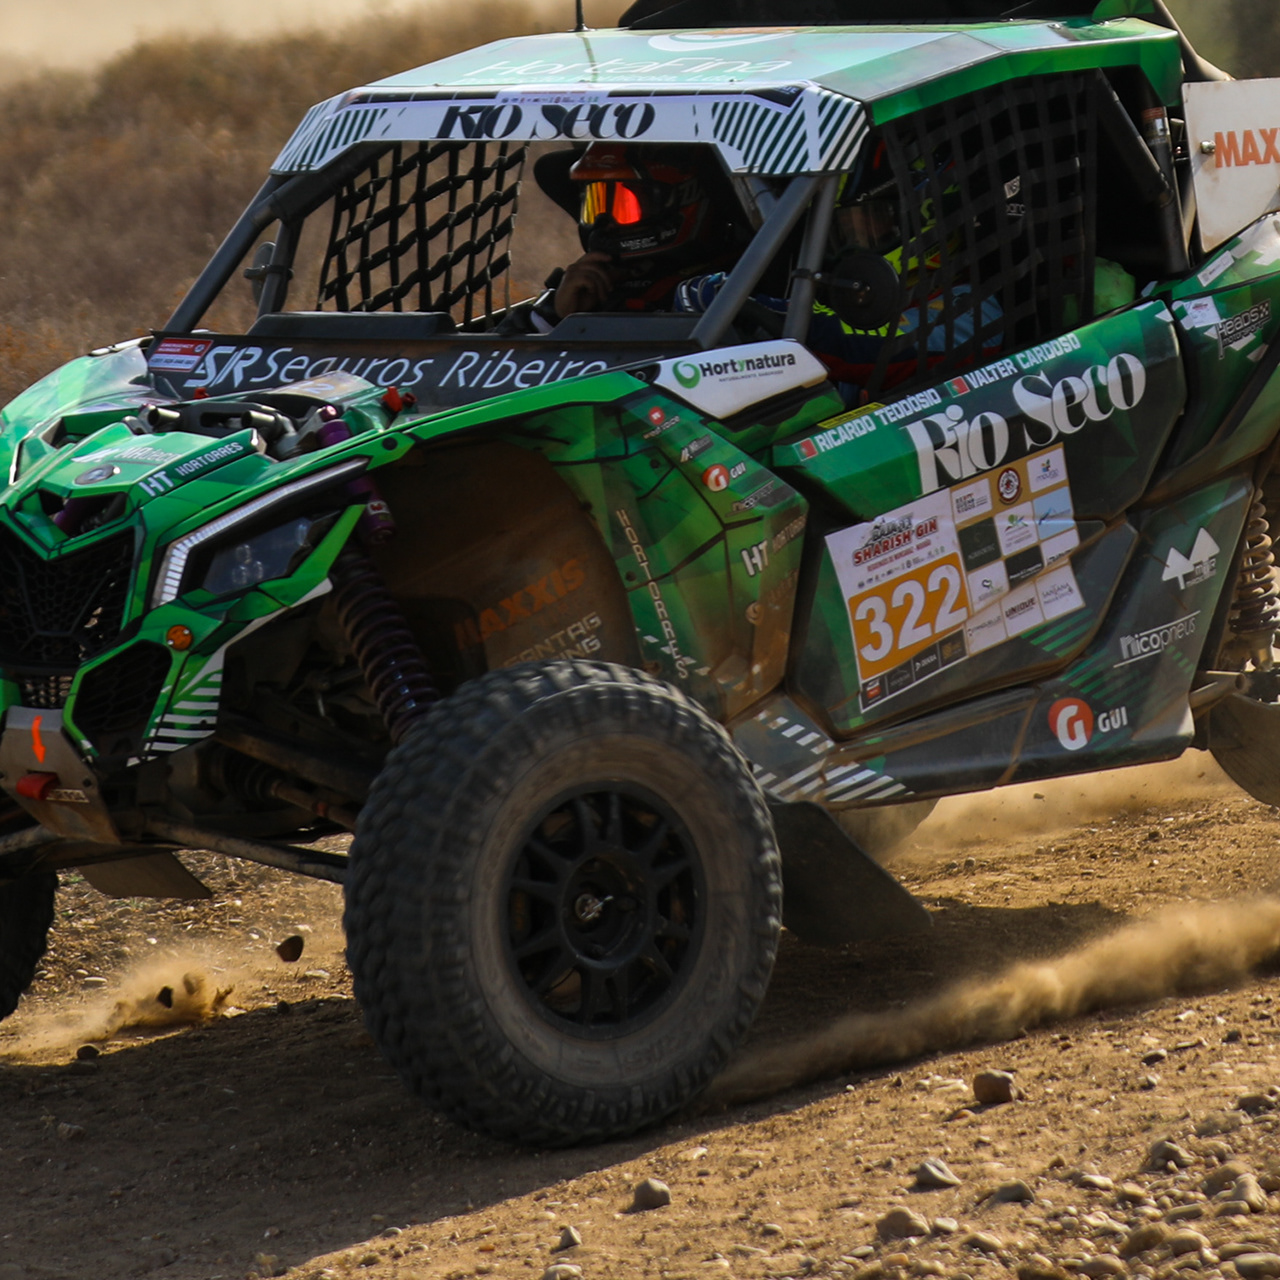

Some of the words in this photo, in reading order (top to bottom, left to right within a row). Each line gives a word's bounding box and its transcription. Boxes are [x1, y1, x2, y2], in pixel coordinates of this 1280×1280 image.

[463, 56, 793, 77] HortaFina
[699, 353, 797, 378] Hortynatura
[814, 414, 877, 453] RICARDO
[964, 358, 1019, 389] VALTER
[1016, 333, 1082, 370] CARDOSO
[898, 404, 1010, 499] Rio
[1011, 353, 1147, 452] Seco
[138, 470, 175, 497] HT
[174, 441, 245, 477] HORTORRES
[730, 462, 747, 479] GUI
[740, 539, 770, 577] HT
[852, 529, 913, 566] SHARISH
[915, 516, 939, 539] GIN
[616, 509, 688, 679] HORTORRES
[854, 563, 969, 663] 322
[1120, 617, 1197, 660] nicopneus
[1098, 706, 1128, 733] GUI
